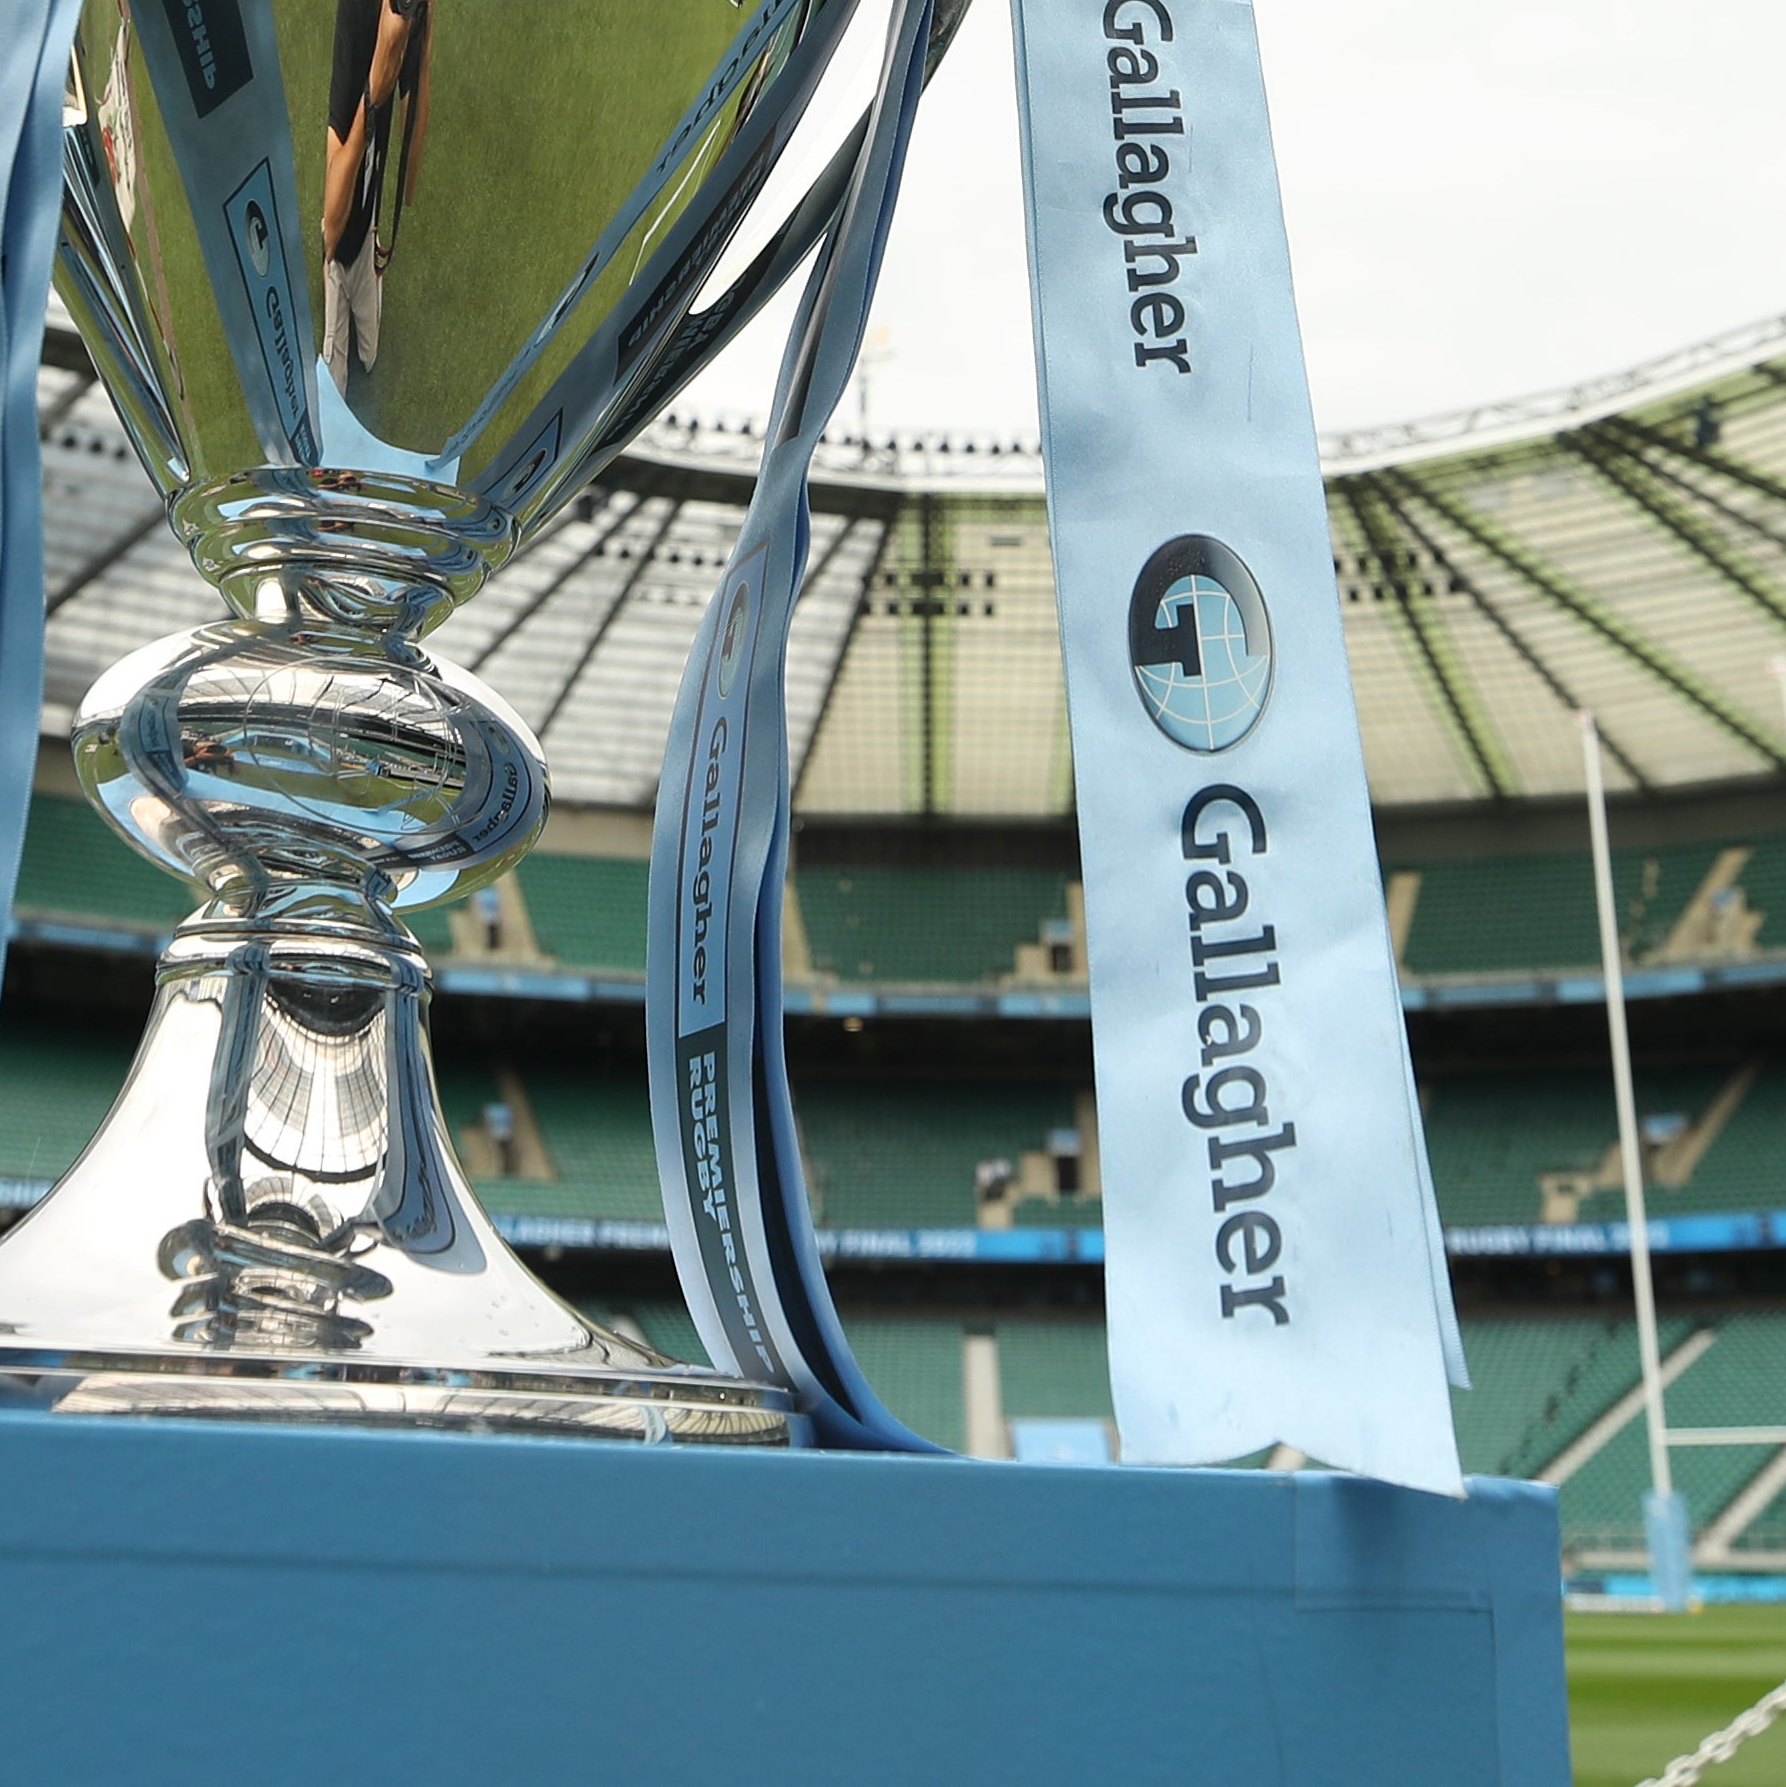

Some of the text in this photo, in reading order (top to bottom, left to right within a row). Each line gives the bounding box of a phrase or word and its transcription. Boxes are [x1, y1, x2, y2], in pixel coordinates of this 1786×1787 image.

[677, 714, 728, 1006] Gallagher
[690, 1056, 716, 1221] RUGBY
[1180, 782, 1296, 1327] Gallagher
[704, 1051, 775, 1375] PREMIERSHIP
